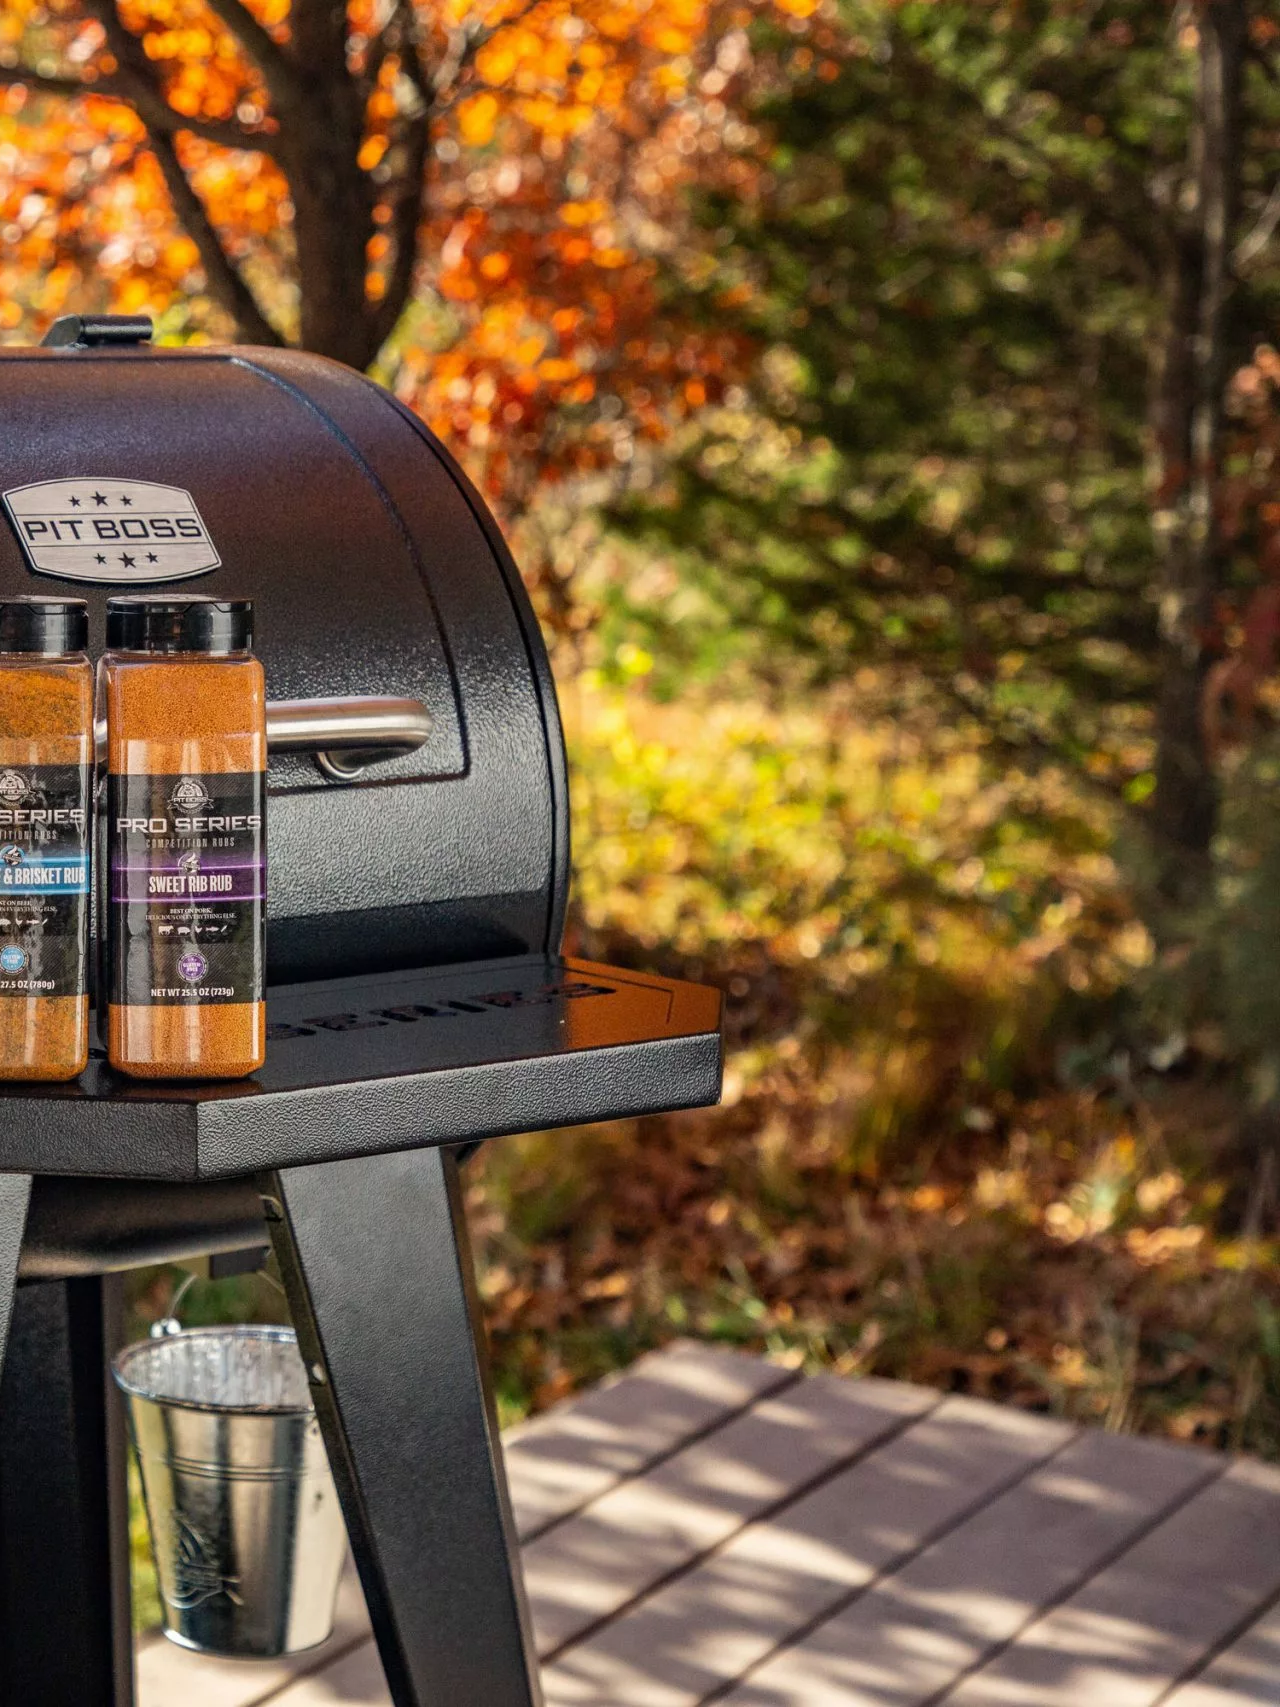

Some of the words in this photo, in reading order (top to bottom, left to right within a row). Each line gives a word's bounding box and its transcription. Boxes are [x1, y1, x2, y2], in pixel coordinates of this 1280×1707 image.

[22, 519, 83, 541] PIT
[93, 518, 202, 540] BOSS
[116, 817, 168, 834] PRO
[174, 815, 261, 833] SERIES
[34, 829, 57, 840] RUBS
[146, 837, 208, 849] COMPETITION
[212, 836, 235, 847] RUBS
[3, 867, 13, 884] &
[14, 867, 62, 884] BRISKET
[63, 867, 86, 884] RUB
[149, 875, 186, 893] SWEET
[188, 875, 208, 892] RIB
[209, 874, 233, 892] RUB
[0, 980, 16, 989] 27.5
[17, 980, 28, 989] OZ
[29, 979, 55, 990] (780g)
[151, 988, 166, 997] NET
[167, 988, 181, 997] WT
[181, 988, 198, 997] 25.5
[198, 987, 210, 996] OZ
[210, 986, 234, 997] (723g)
